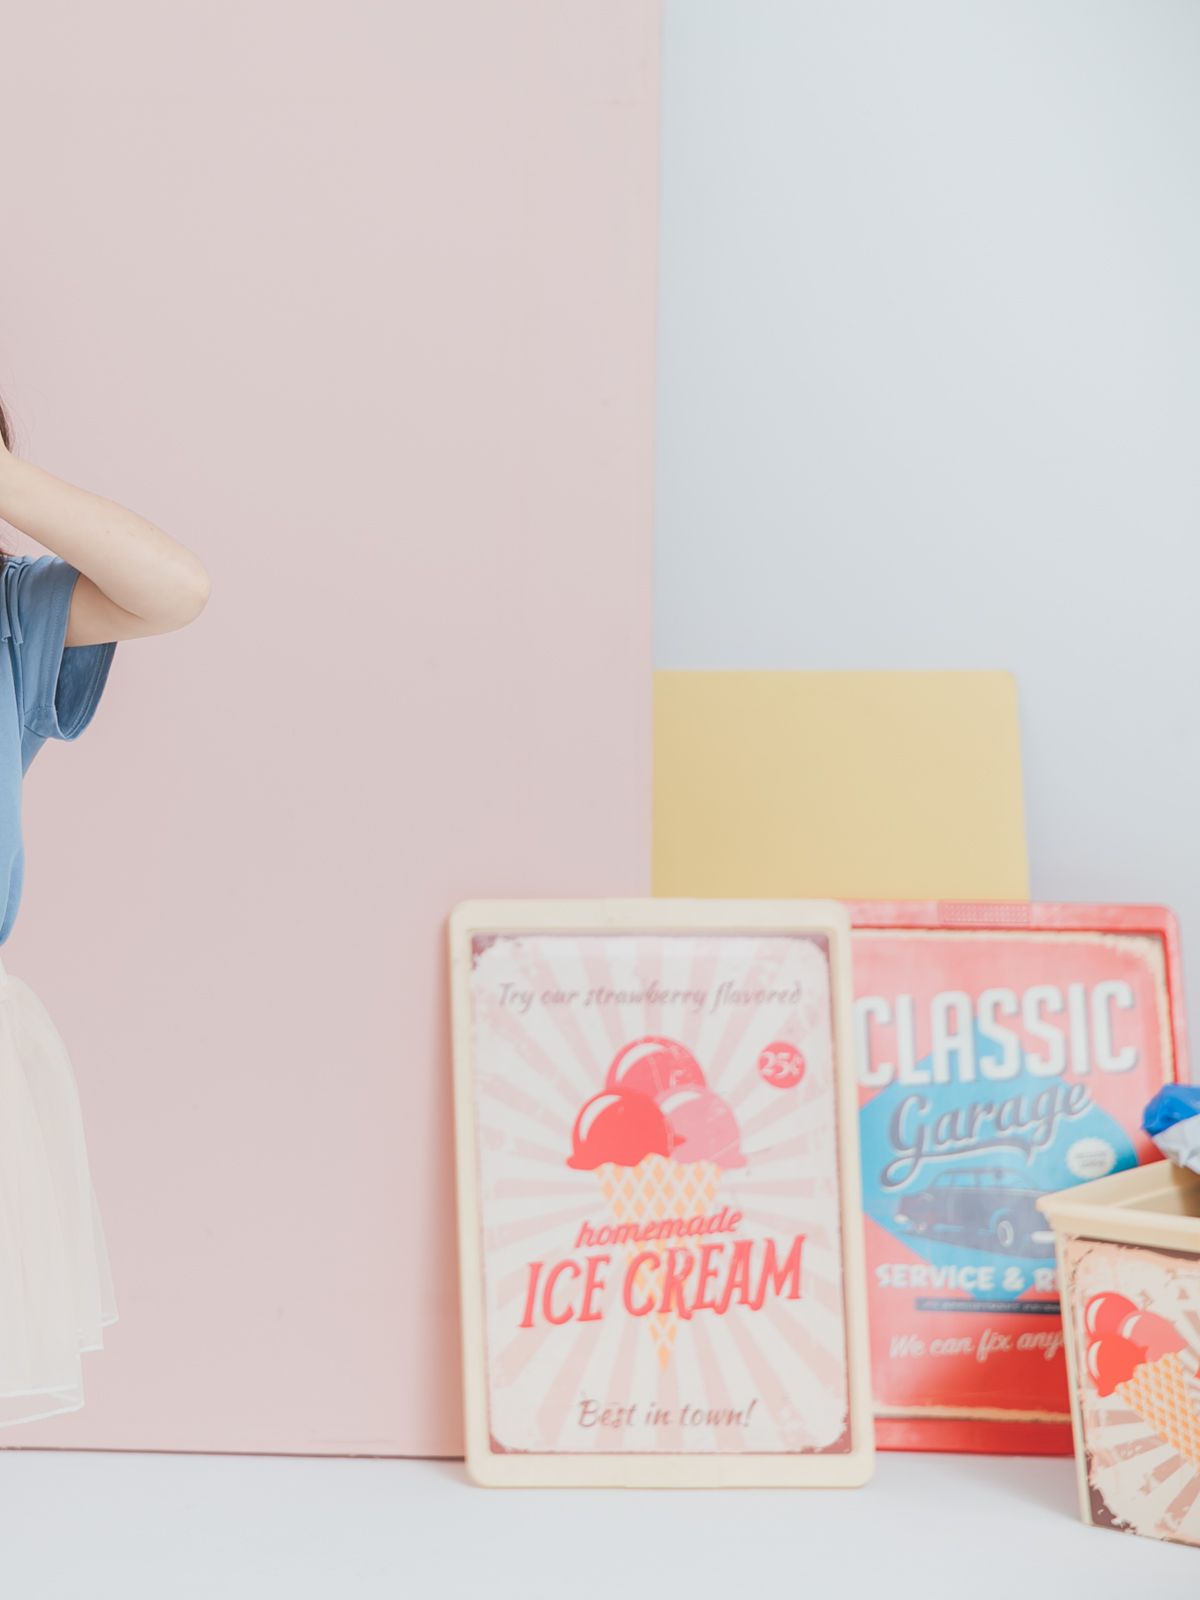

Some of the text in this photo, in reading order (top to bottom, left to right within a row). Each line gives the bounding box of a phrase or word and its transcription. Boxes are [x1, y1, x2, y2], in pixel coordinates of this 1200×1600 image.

[584, 979, 706, 1014] strawberry
[709, 978, 802, 1015] flavored
[853, 978, 1139, 1088] CLASSIC
[879, 1081, 1093, 1193] Garage
[574, 1204, 743, 1249] homemade
[517, 1233, 807, 1329] ICE CREAM
[874, 1263, 1059, 1293] SERVICE & R
[889, 1328, 1065, 1364] We can fix any
[577, 1398, 759, 1429] Best in town!
